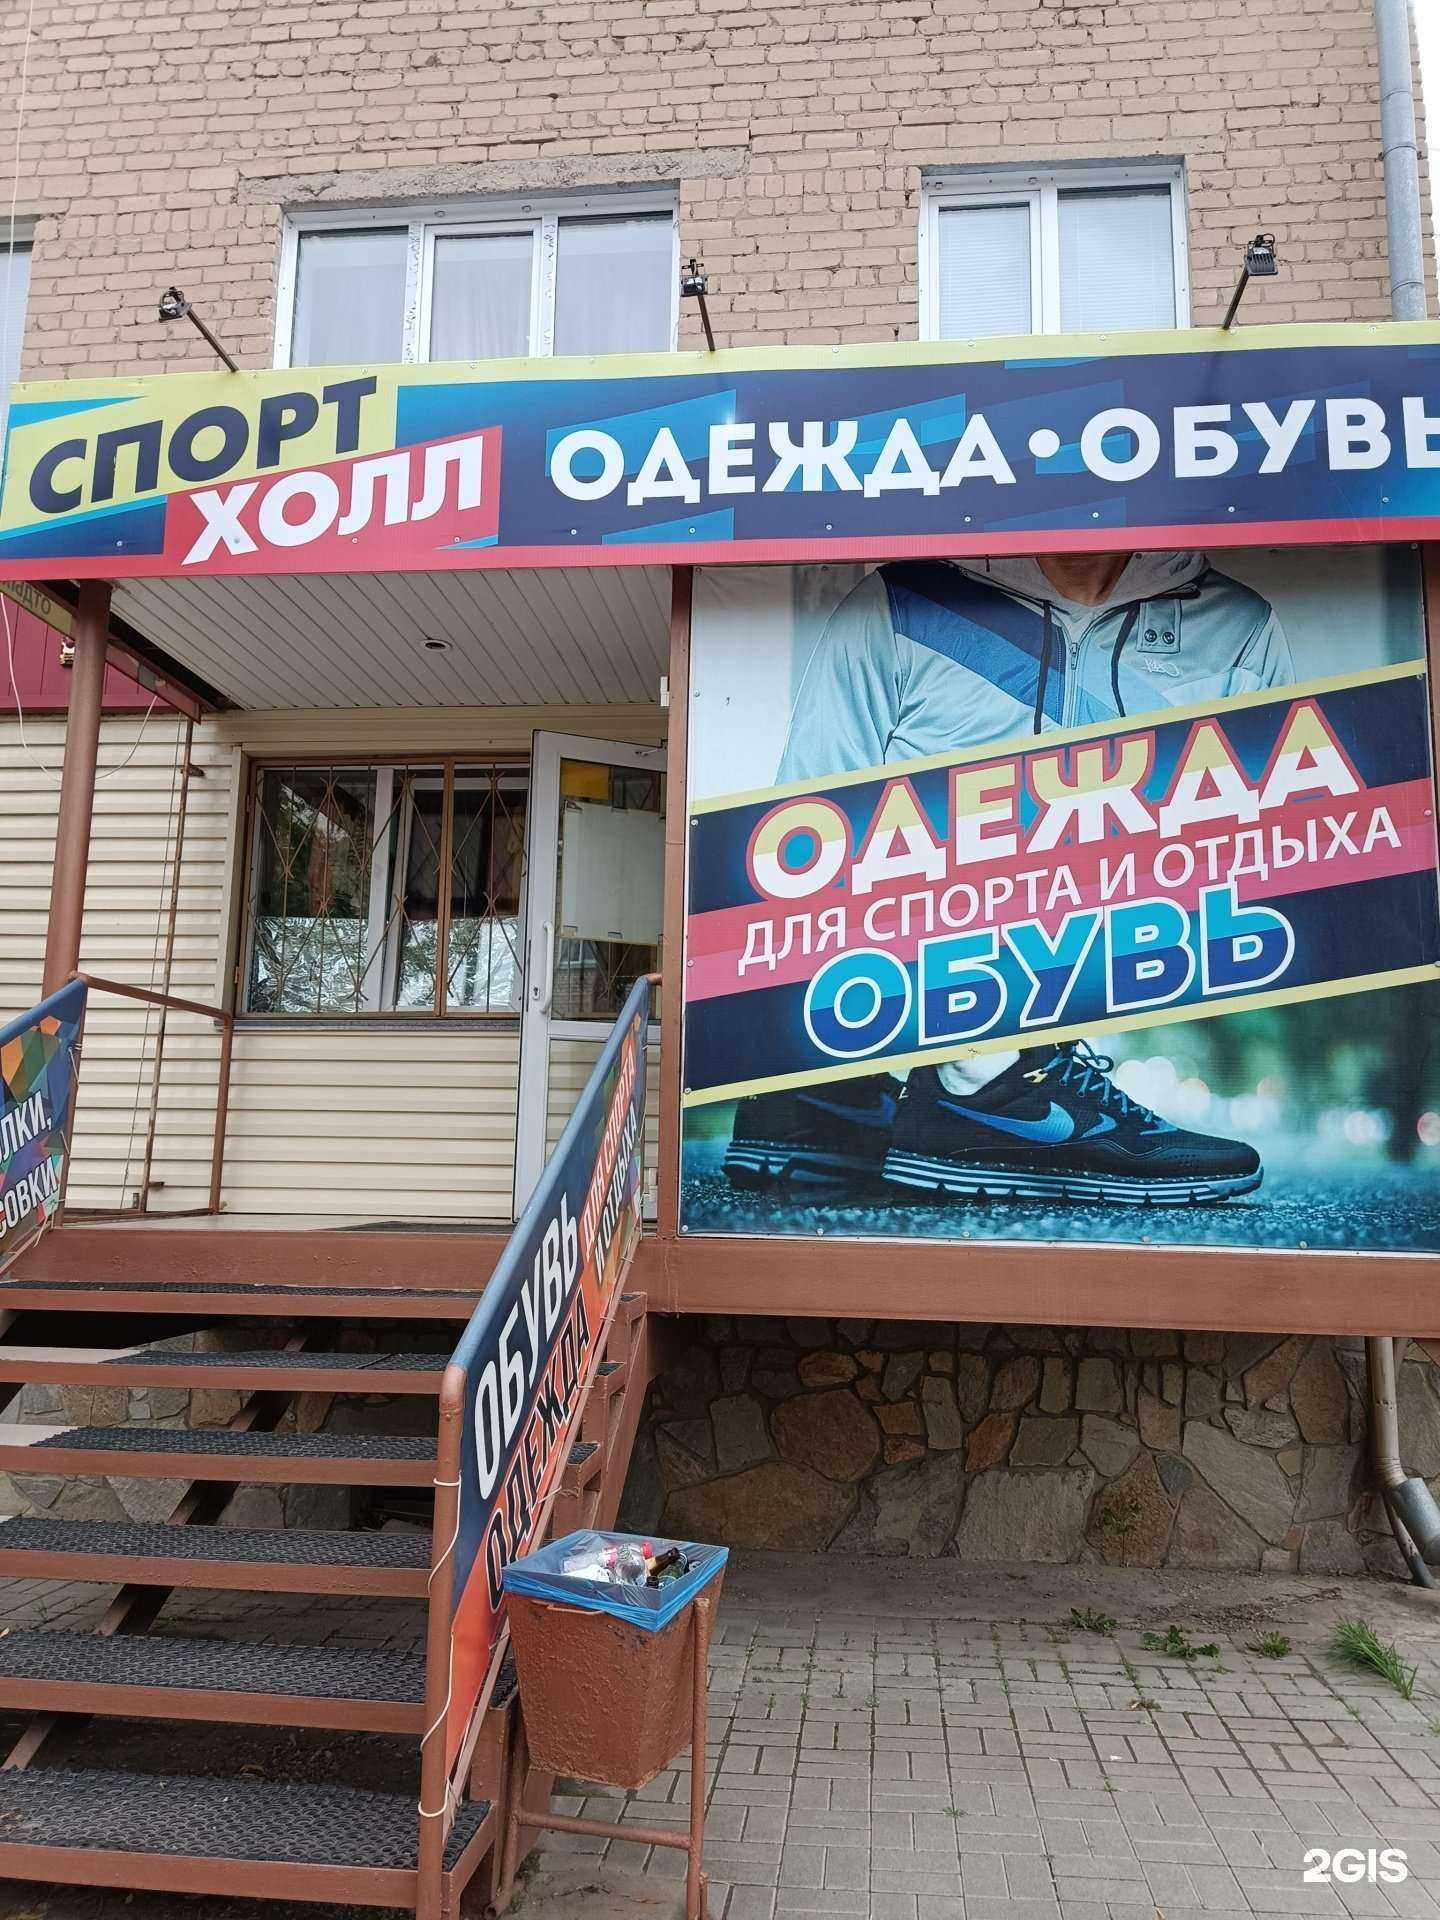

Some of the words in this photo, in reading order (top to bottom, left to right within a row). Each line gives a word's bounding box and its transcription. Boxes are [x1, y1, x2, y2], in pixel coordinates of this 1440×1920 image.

[29, 376, 377, 514] СПОРТ
[181, 435, 483, 566] ХОЛЛ
[550, 413, 1017, 506] ОДЕЖДА
[746, 699, 1366, 900] ОДЕЖДА
[737, 905, 847, 976] ДЛЯ
[863, 863, 1084, 942] СПОРТА
[1099, 857, 1138, 902] И
[1152, 805, 1402, 890] ОТДЫХА
[803, 881, 1296, 1058] ОБУВЬ
[0, 1090, 51, 1166] ЛКИ,
[584, 1154, 606, 1263] ДЛЯ
[603, 1043, 636, 1174] СПОРТА
[602, 1101, 637, 1250] ОТДЫХА
[475, 1192, 578, 1500] ОБУВЬ
[485, 1283, 591, 1614] ОДЕЖДА
